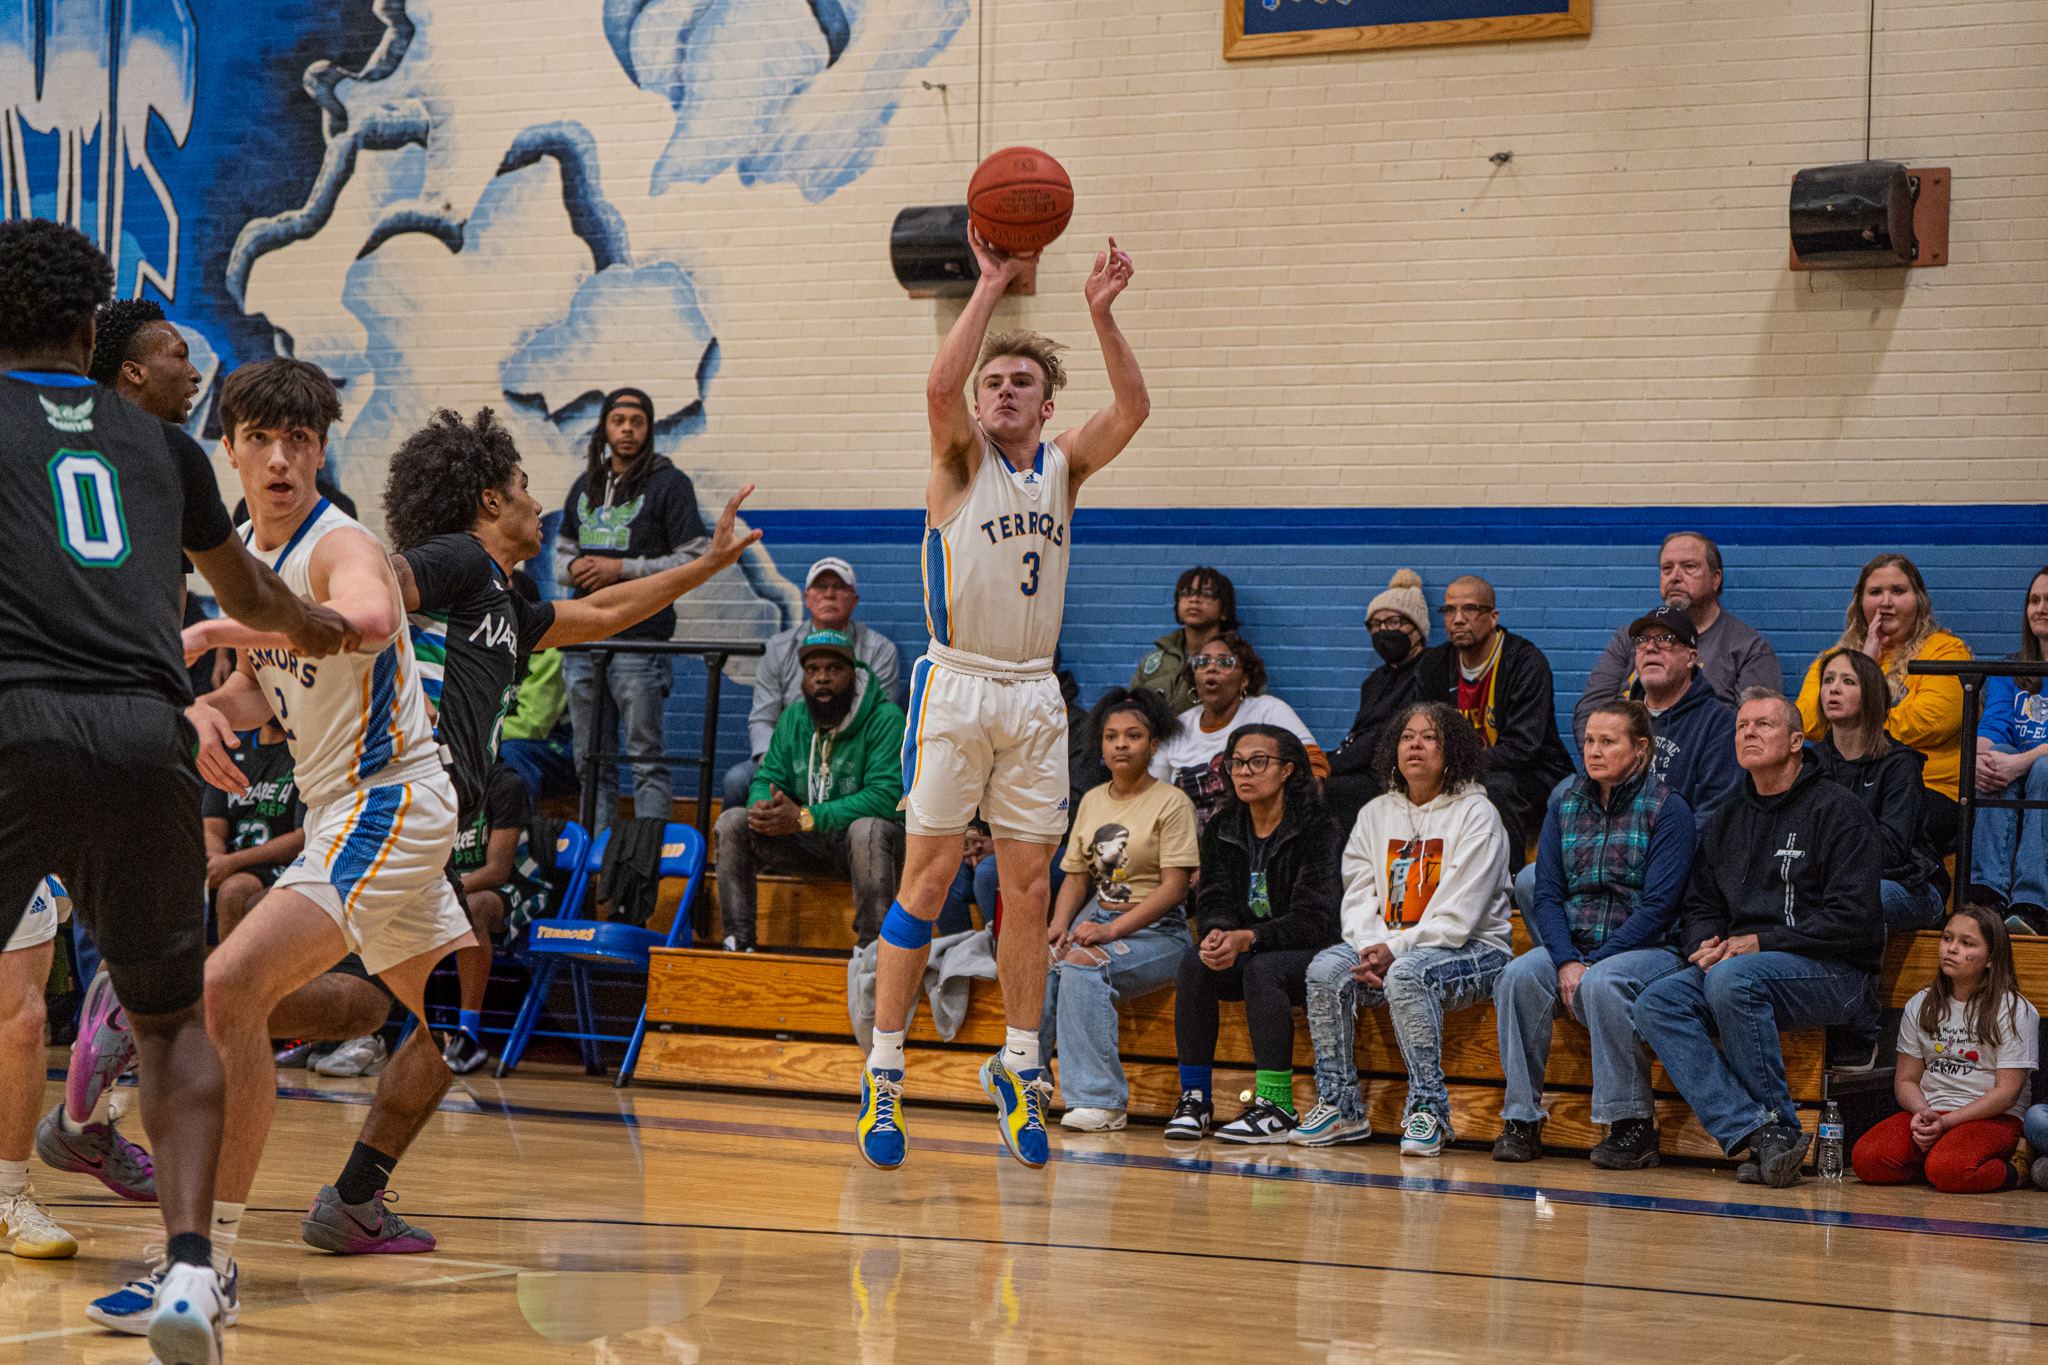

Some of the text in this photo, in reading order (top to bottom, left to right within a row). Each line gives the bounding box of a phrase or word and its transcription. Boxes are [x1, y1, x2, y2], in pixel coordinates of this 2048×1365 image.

[47, 447, 131, 568] 0
[980, 511, 1064, 547] TERRORS
[1020, 551, 1040, 597] 3
[248, 648, 318, 690] ERRORS
[1653, 736, 1681, 757] STONE
[536, 925, 596, 945] TERRORS
